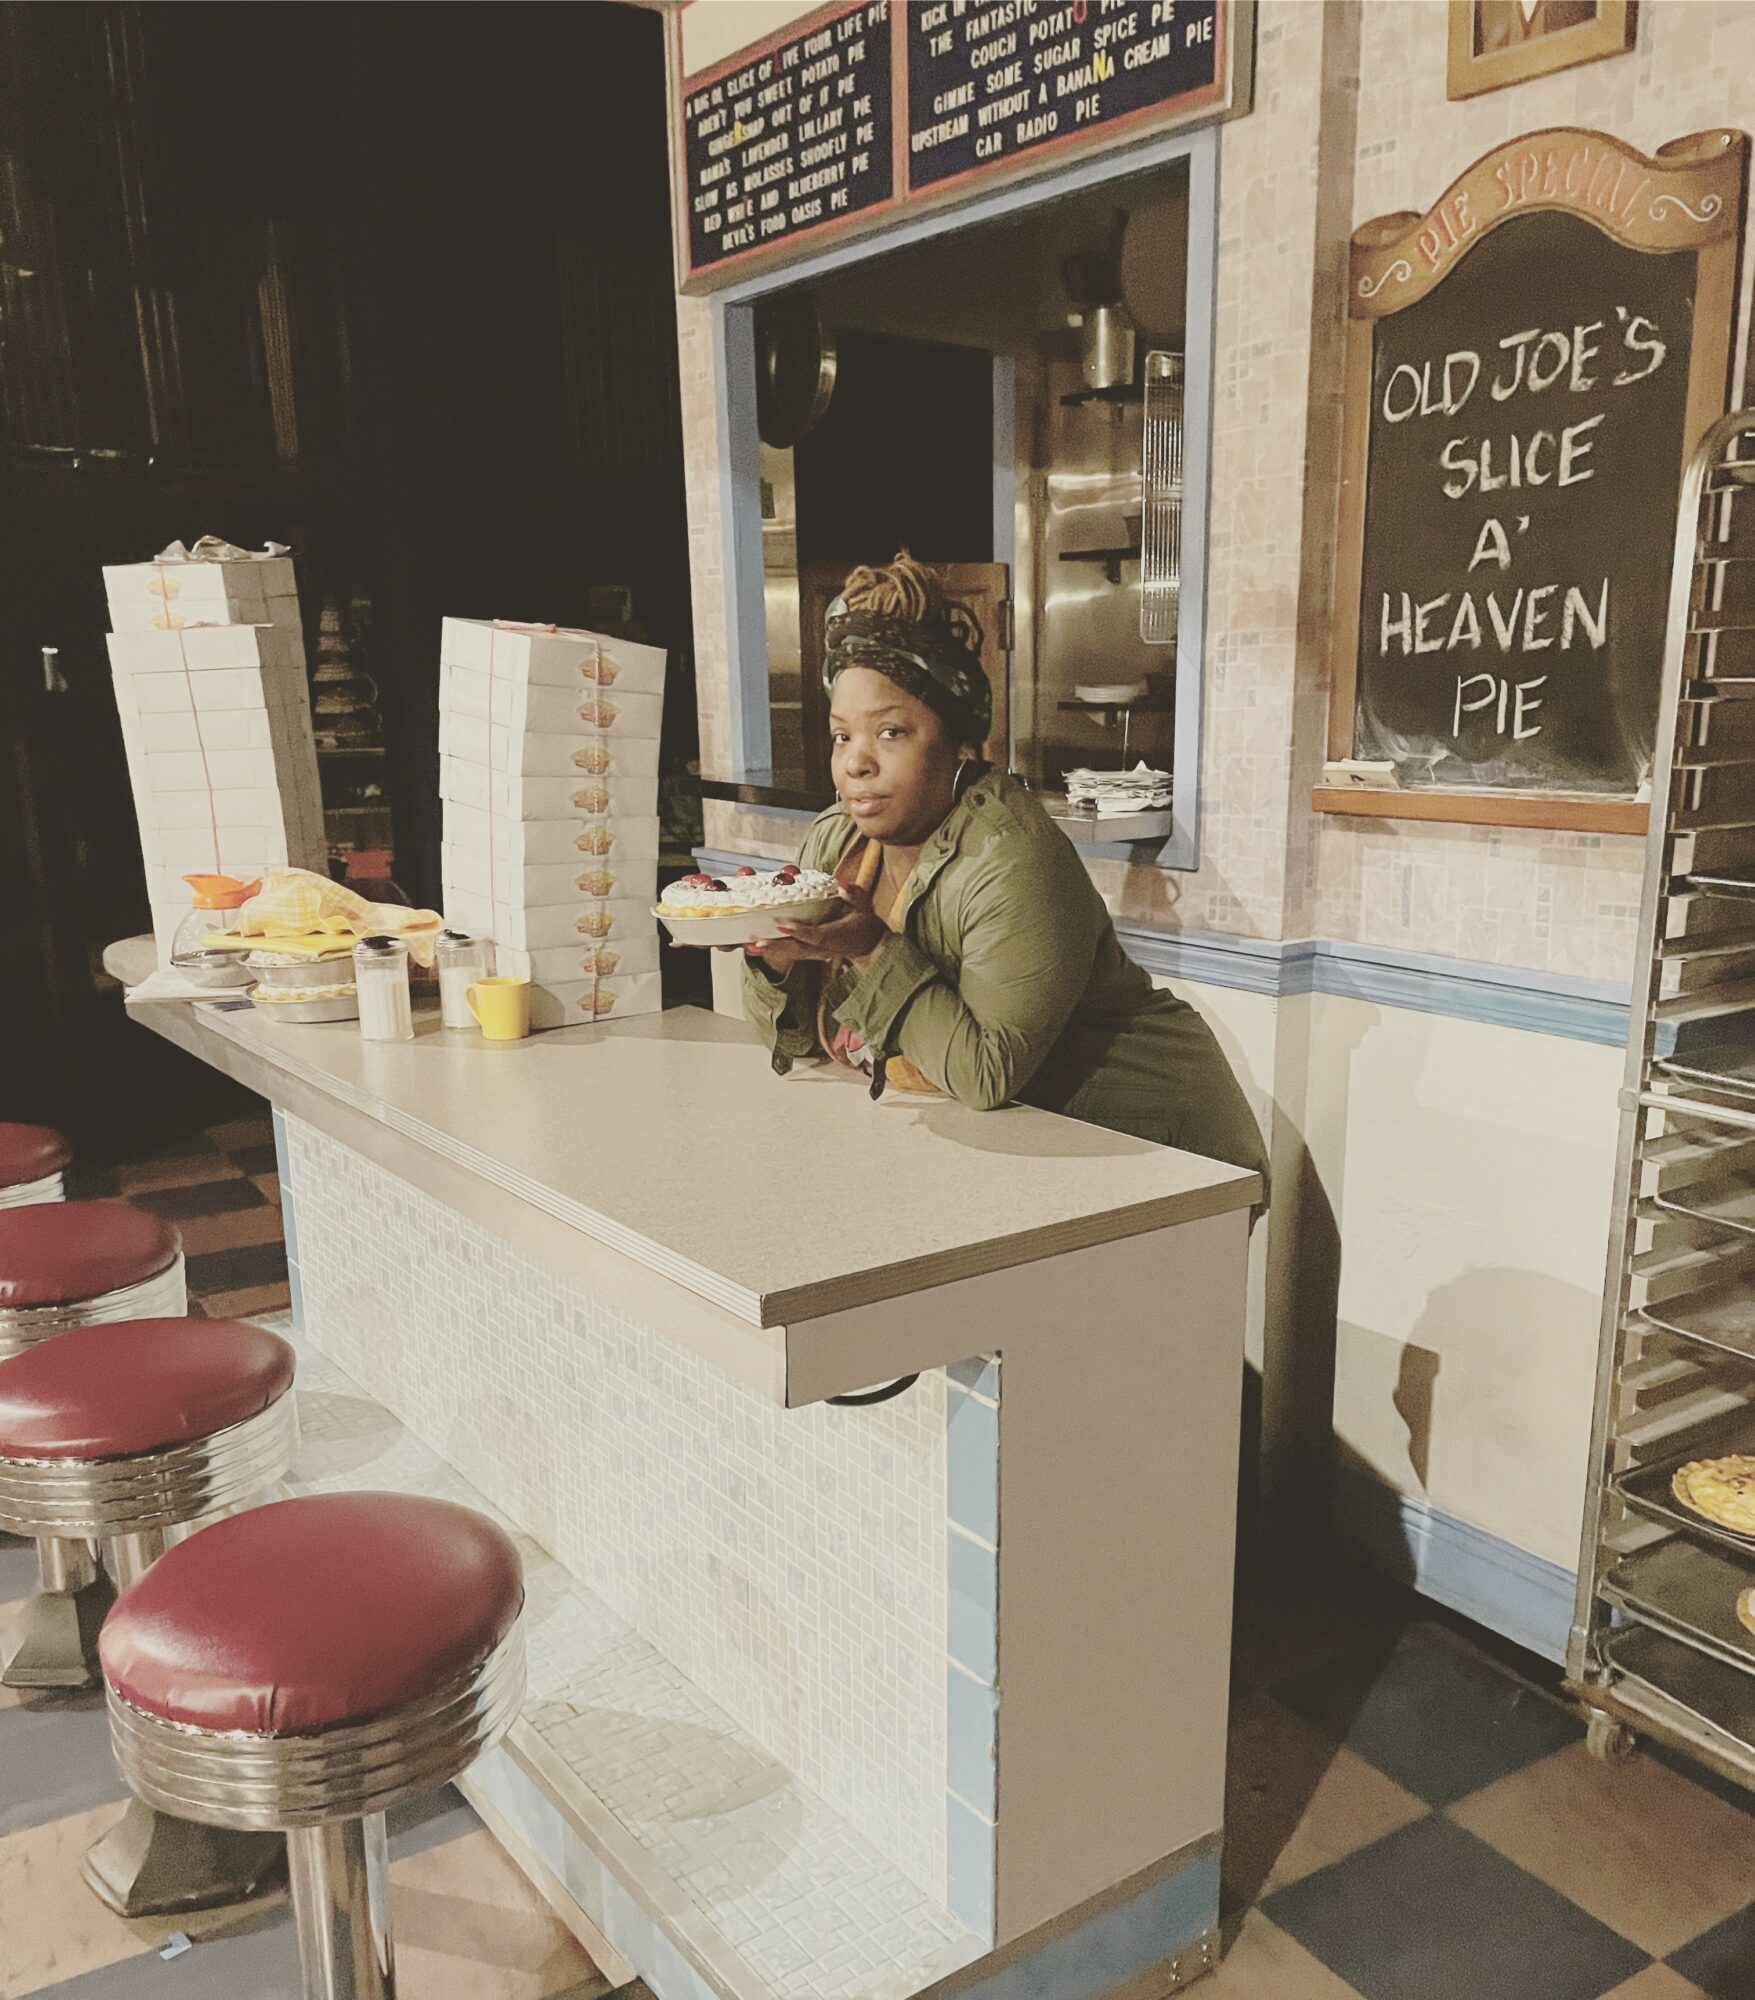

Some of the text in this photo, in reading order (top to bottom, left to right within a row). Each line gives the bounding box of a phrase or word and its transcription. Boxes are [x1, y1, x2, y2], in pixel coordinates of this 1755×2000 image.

[727, 68, 755, 97] SLICE
[758, 60, 773, 82] OF
[804, 29, 832, 59] YOUR
[837, 12, 863, 42] LIFE
[868, 0, 888, 27] PIE
[921, 3, 948, 32] KICK
[929, 0, 1037, 58] THE FANTASTIC
[970, 31, 1017, 69] COUCH
[1029, 0, 1087, 46] POTATO
[758, 76, 793, 108] SWEET
[802, 53, 840, 88] POTATO
[848, 40, 866, 66] PIE
[911, 16, 1213, 152] UPSTREAM WITHOUT A BANANA CREAM PIE
[934, 81, 976, 115] GIMME
[986, 61, 1023, 93] SOME
[1033, 37, 1080, 74] SUGAR
[1094, 12, 1138, 49] SPICE
[771, 103, 793, 127] OUT
[799, 94, 814, 115] OF
[838, 73, 856, 98] PIE
[799, 106, 844, 143] LULLABY
[853, 94, 872, 119] PIE
[976, 94, 1100, 158] CAR RADIO PIE
[726, 181, 738, 200] AS
[744, 156, 794, 193] MOLASSES
[800, 132, 848, 168] SHOOFLY
[857, 121, 875, 146] PIE
[760, 188, 780, 211] AND
[788, 161, 846, 200] BLUEBERRY
[852, 151, 870, 175] PIE
[760, 212, 787, 237] FOOD
[791, 198, 822, 225] OASIS
[831, 187, 849, 211] PIE
[1418, 147, 1651, 273] PIE SPECIAL
[1383, 306, 1666, 423] OLD JOE'S
[1440, 413, 1605, 499] SLICE
[1468, 515, 1530, 573] A'
[1380, 577, 1608, 656] HEAVEN
[1452, 673, 1547, 739] PIE
